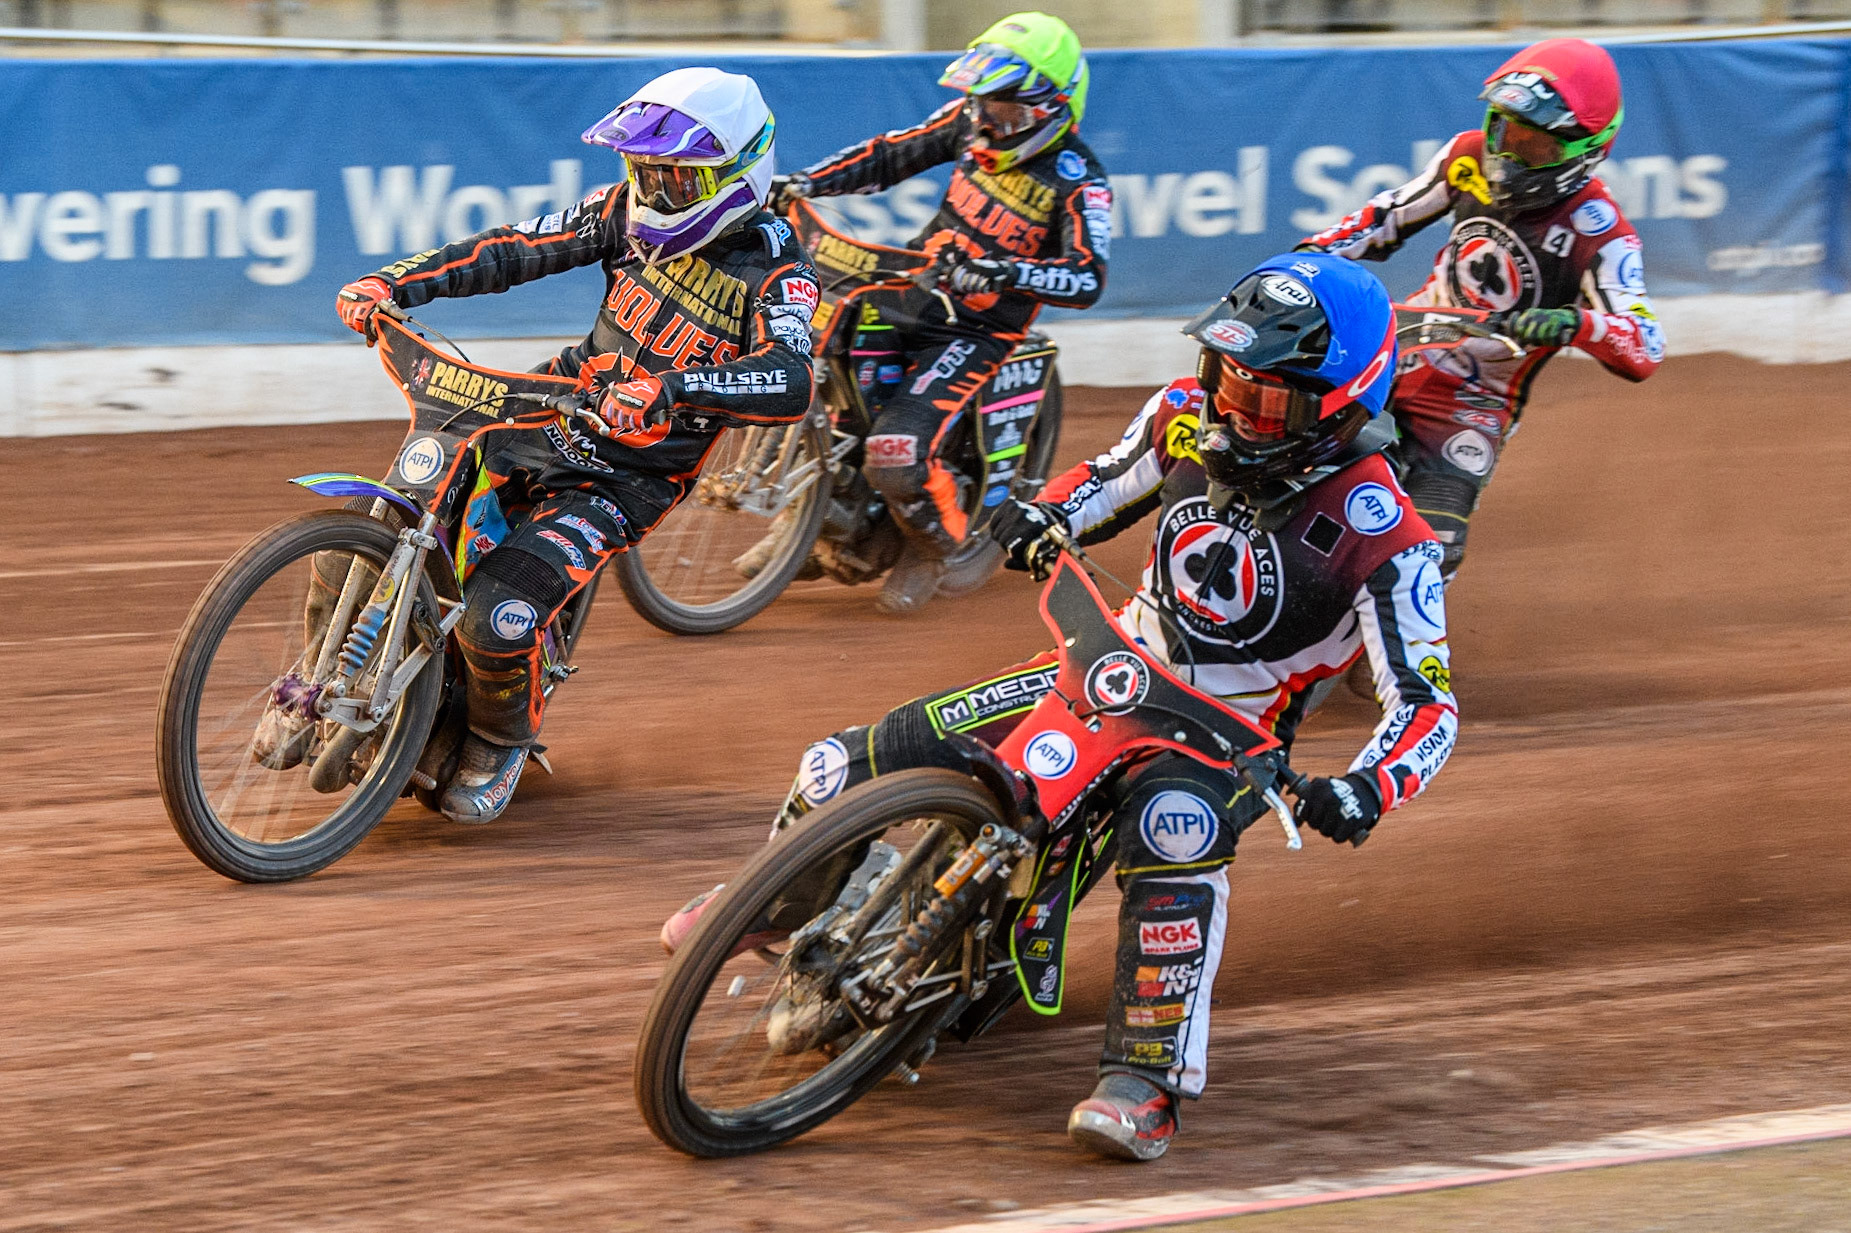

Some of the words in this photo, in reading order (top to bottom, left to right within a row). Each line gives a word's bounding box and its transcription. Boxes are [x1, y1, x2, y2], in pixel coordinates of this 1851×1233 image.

[1550, 232, 1567, 251] 4
[1014, 262, 1098, 296] Taffys
[1275, 281, 1309, 302] Arai
[1208, 325, 1247, 345] STS
[430, 362, 509, 407] PARRYS
[683, 369, 787, 386] BULLSEYE
[426, 385, 500, 419] INTERNATIONAL
[408, 452, 434, 469] ATPI
[1169, 505, 1217, 533] BELLE
[1227, 512, 1262, 542] VUE
[1255, 547, 1275, 597] ACES
[499, 610, 528, 624] ATPI
[941, 700, 970, 723] M
[1035, 742, 1065, 769] ATPI
[809, 751, 828, 795] ATPI
[1153, 812, 1206, 837] ATPI
[1142, 922, 1197, 944] NGK
